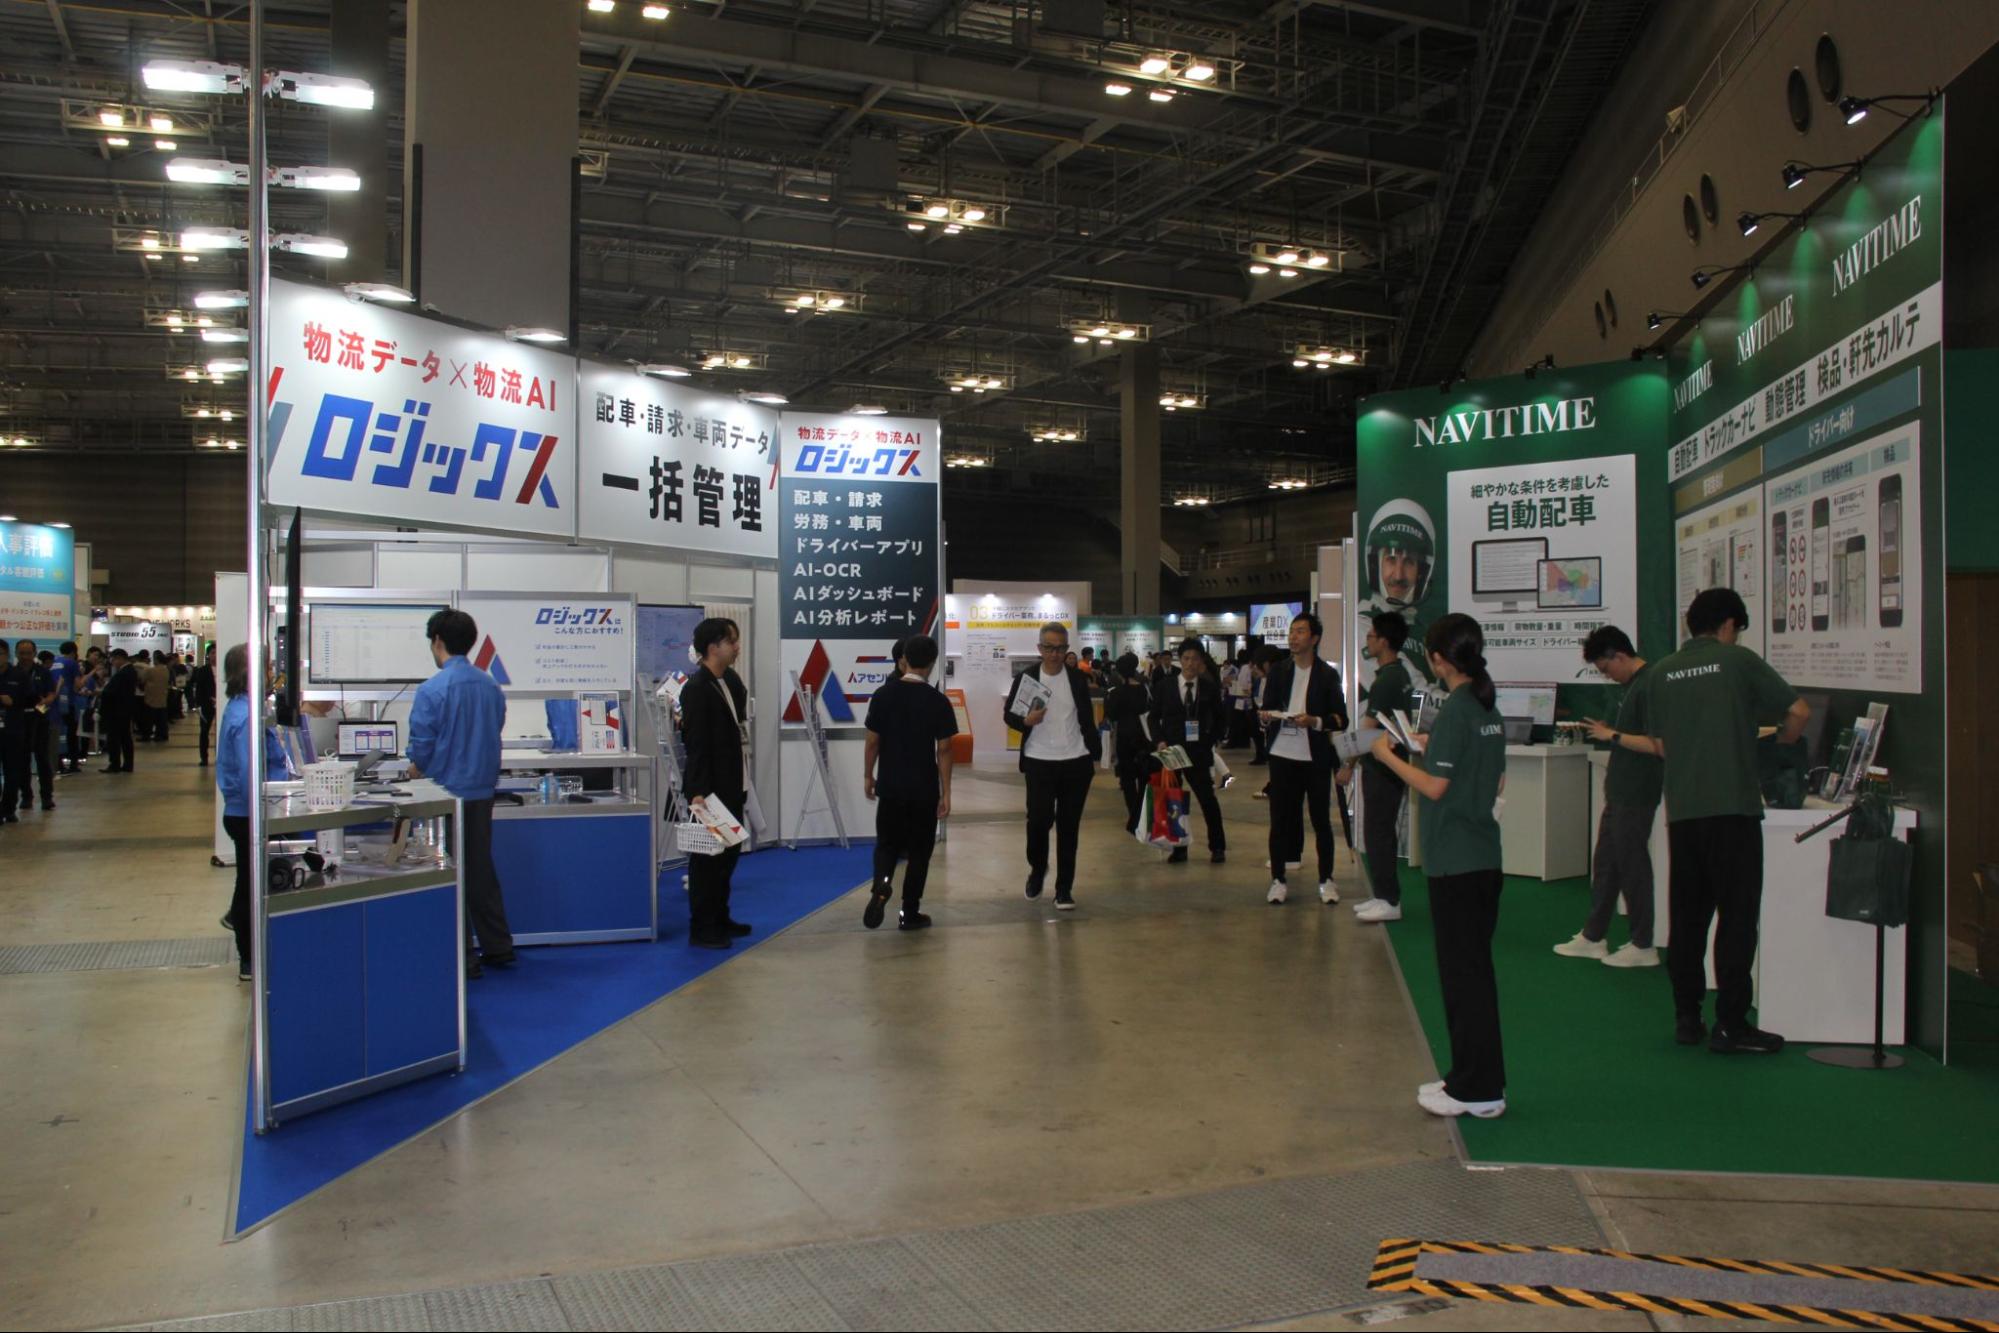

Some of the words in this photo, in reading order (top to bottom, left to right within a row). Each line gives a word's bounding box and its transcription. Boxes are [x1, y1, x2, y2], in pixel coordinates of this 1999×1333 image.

[1832, 195, 1921, 297] NAVITIME
[1737, 294, 1793, 366] NAVITIME
[1673, 359, 1713, 414] NAVITIME
[1704, 397, 1756, 458] トラックカーナビ
[1765, 370, 1806, 424] 動態管理
[1817, 302, 1921, 397] 検品・軒先カルテ
[596, 390, 769, 455] 配車・請求・車両データ
[1413, 396, 1596, 448] NAVITIME
[301, 393, 559, 508] ロジックス
[794, 443, 922, 477] ロジックス
[602, 455, 762, 532] 一括管理
[793, 489, 883, 508] 配車・請求
[1470, 473, 1610, 499] 細やかな条件を考慮した
[793, 513, 883, 532] 労務・車両
[1487, 494, 1596, 532] 自動配車
[1380, 522, 1424, 540] NAVITIME
[796, 537, 923, 556] ドライバーアプリ
[793, 562, 862, 578] AI-OCR
[793, 585, 923, 602] AIダッシュボード
[793, 609, 917, 627] AI分析レポート
[857, 672, 888, 684] アセン
[1666, 664, 1721, 682] NAVITIME
